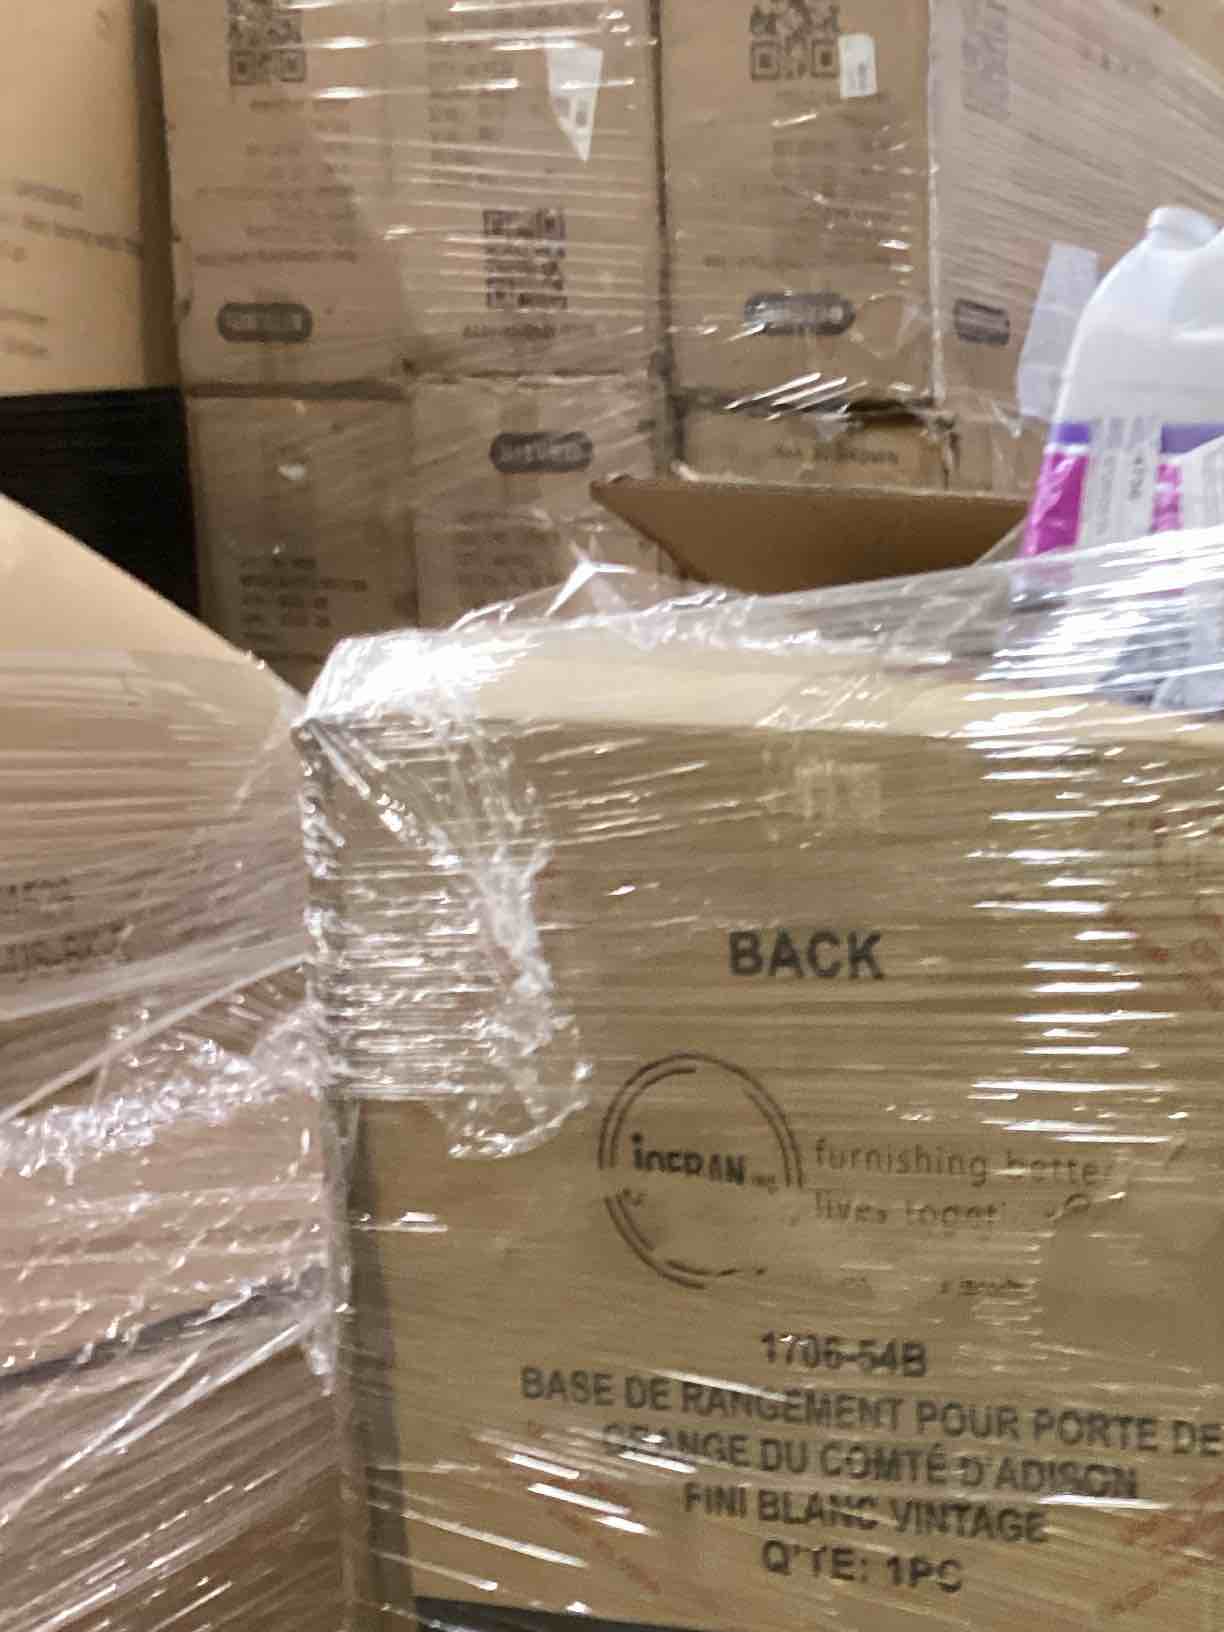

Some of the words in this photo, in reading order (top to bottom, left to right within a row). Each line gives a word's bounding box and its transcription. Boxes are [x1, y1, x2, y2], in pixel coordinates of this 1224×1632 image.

[730, 930, 887, 979] BACK
[815, 1138, 988, 1187] furnishing
[1007, 1150, 1113, 1186] bette
[521, 1366, 614, 1407] BASE
[624, 1375, 673, 1412] DE
[682, 1380, 903, 1432] RANGEMENT
[916, 1401, 1021, 1441] POUR
[1032, 1408, 1158, 1453] PORTE
[1171, 1418, 1224, 1457] DE
[758, 1437, 811, 1475] DU
[684, 1481, 747, 1519] FINI
[758, 1489, 879, 1530] BLANC
[889, 1500, 1050, 1543] VINTAGE
[887, 1557, 964, 1594] 1PC
